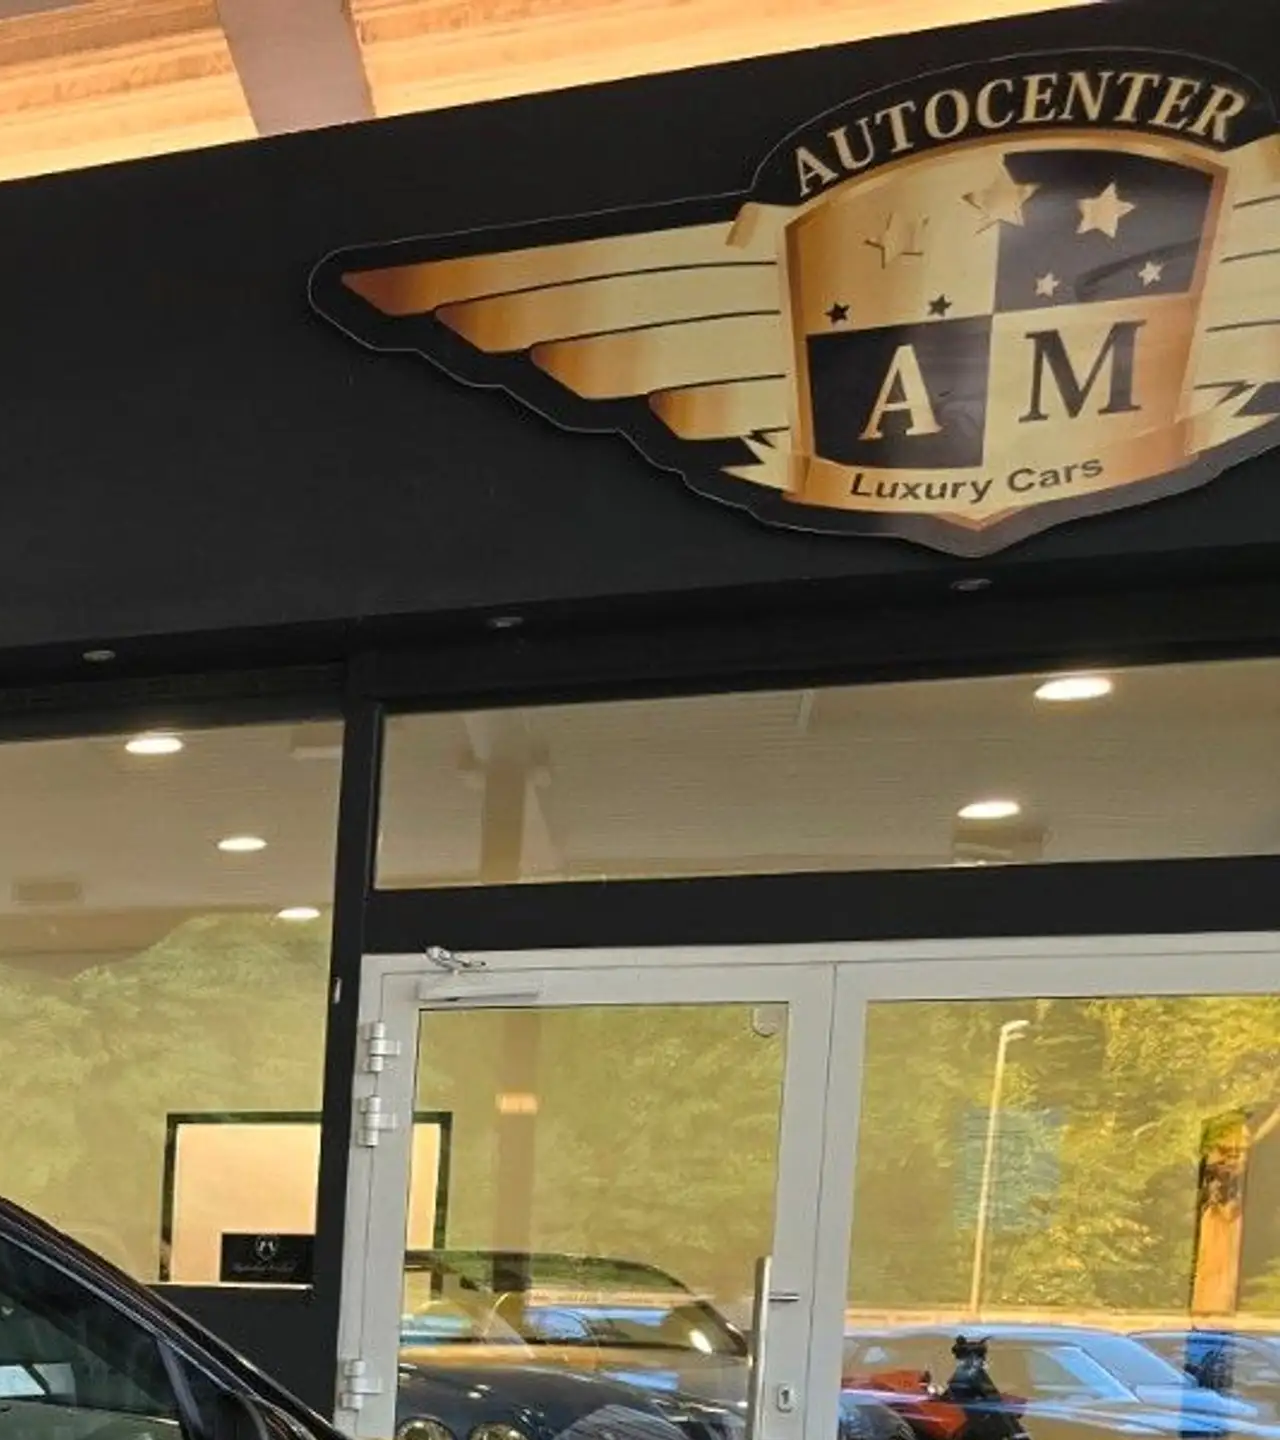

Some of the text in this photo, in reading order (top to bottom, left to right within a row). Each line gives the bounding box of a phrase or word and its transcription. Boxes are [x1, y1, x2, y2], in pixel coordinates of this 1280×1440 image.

[793, 71, 1247, 196] AUTOCENTER
[859, 320, 1147, 440] A M
[851, 458, 1103, 503] Luxury Cars
